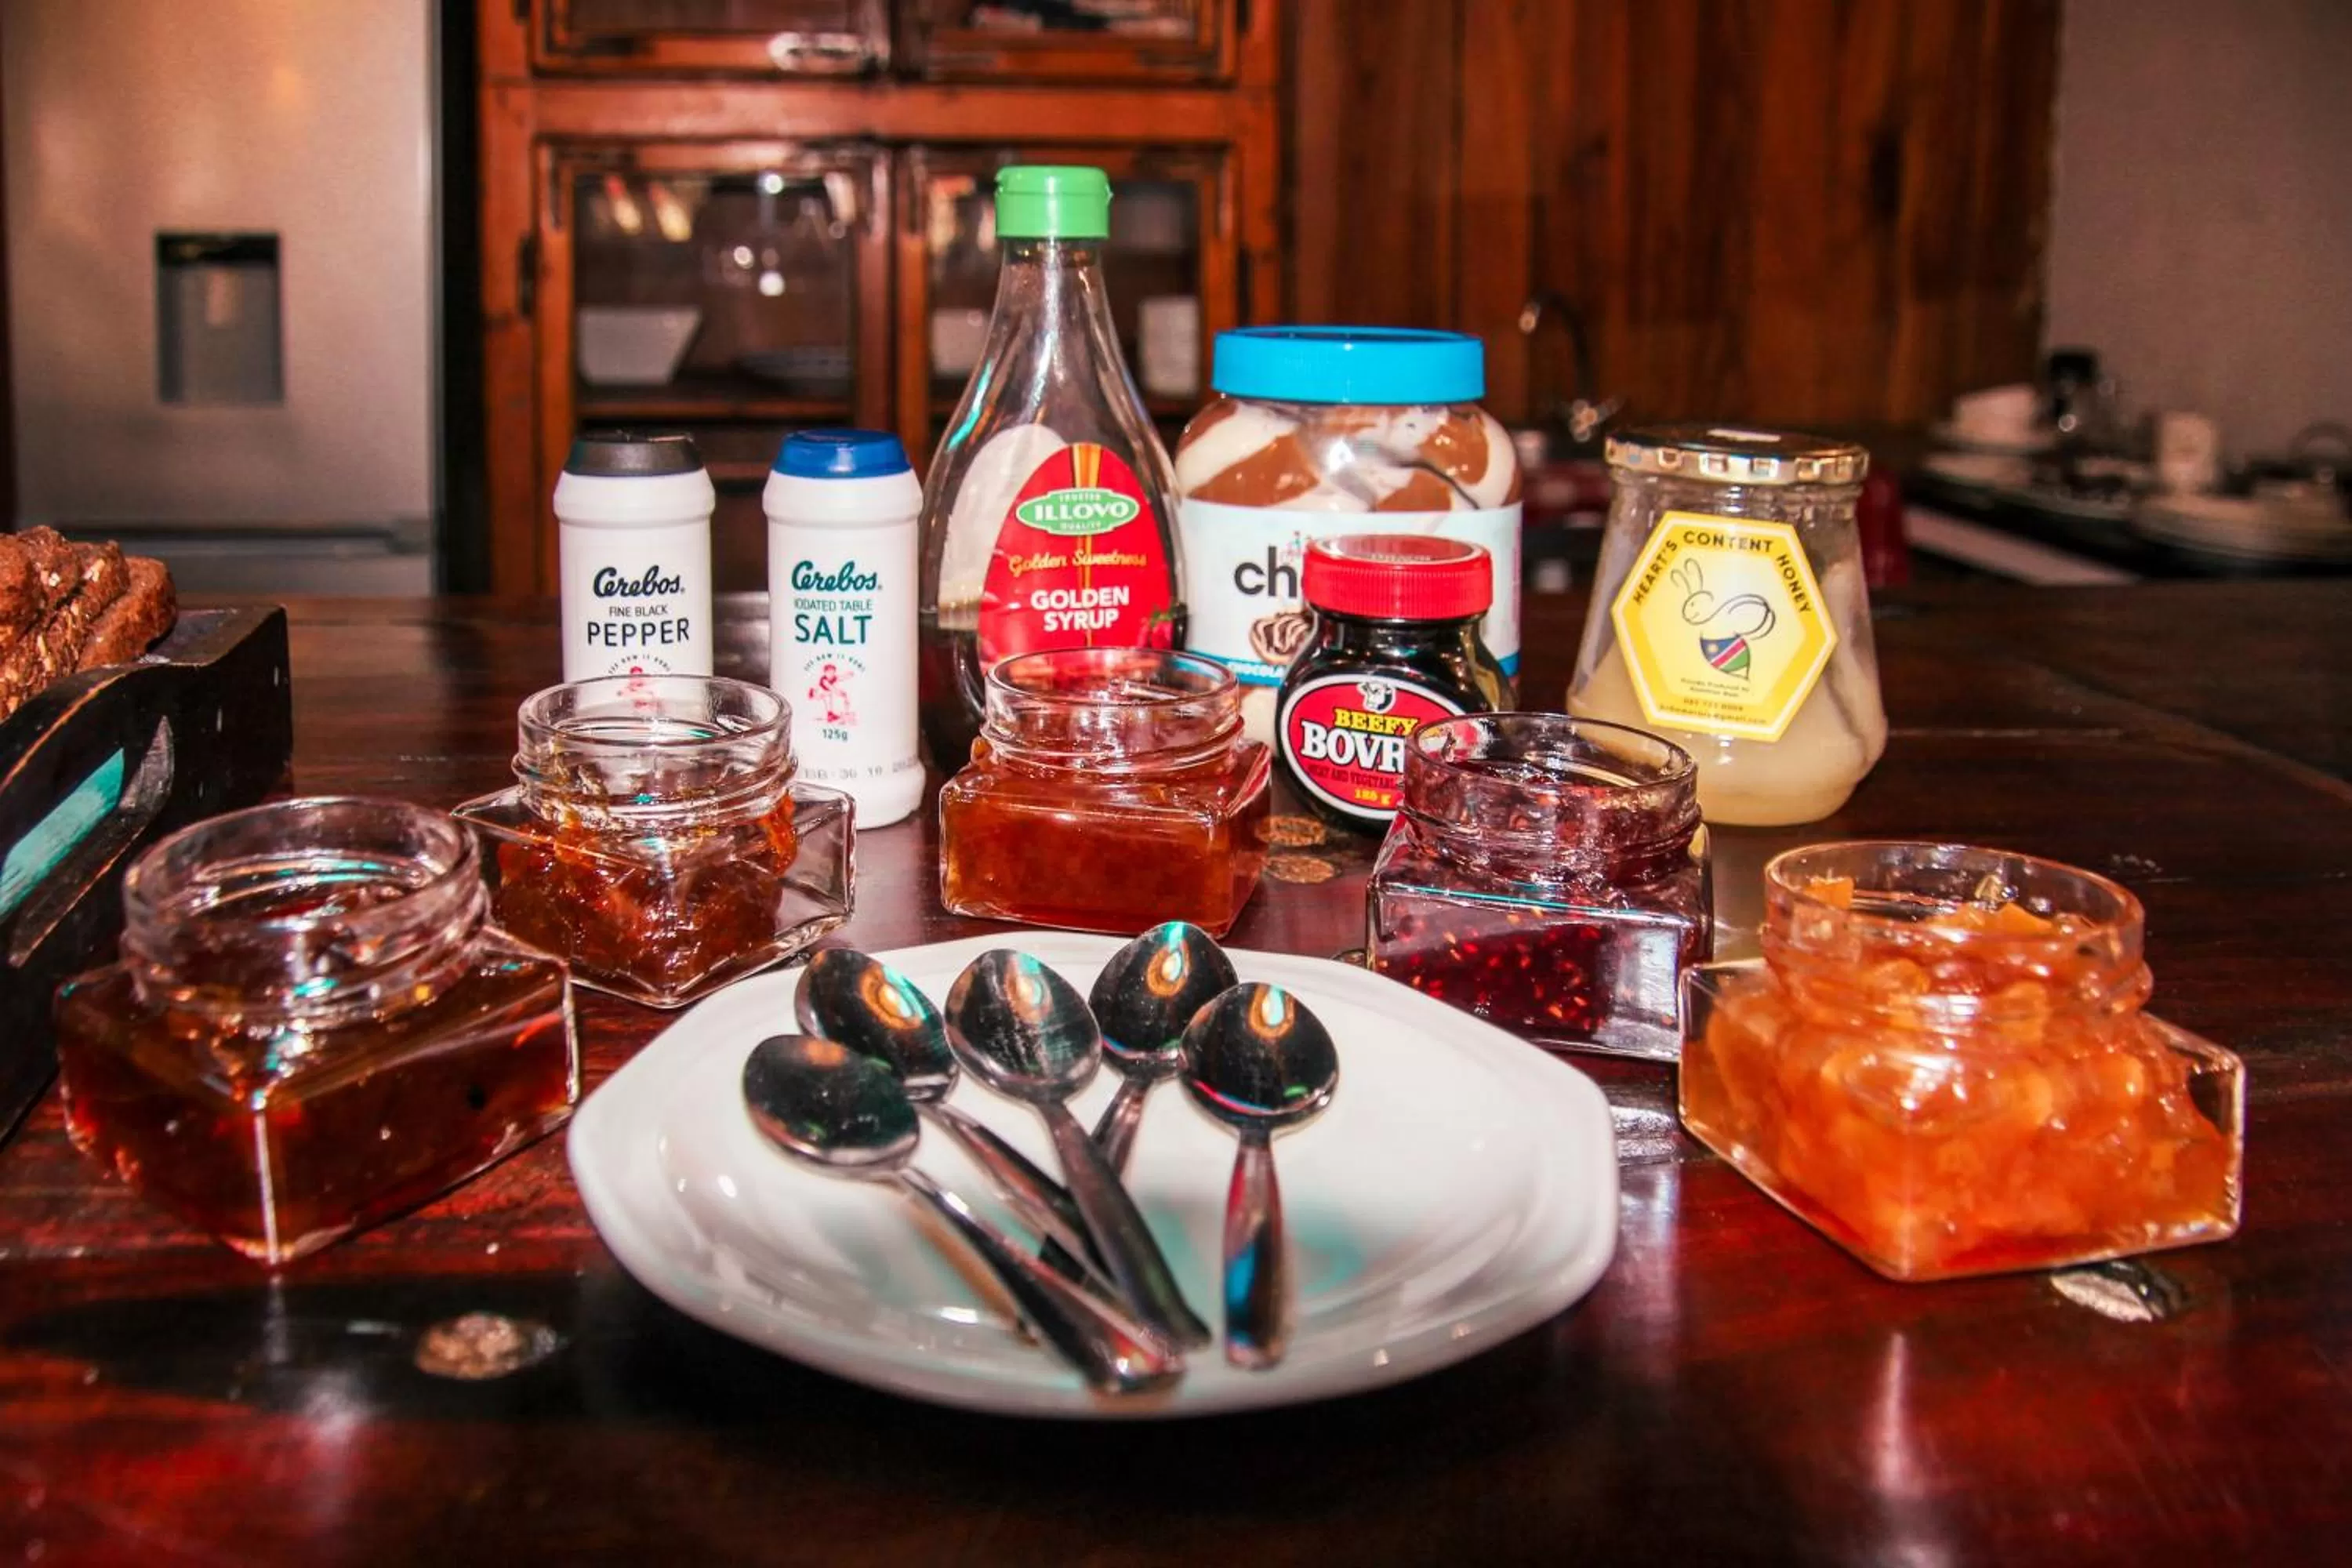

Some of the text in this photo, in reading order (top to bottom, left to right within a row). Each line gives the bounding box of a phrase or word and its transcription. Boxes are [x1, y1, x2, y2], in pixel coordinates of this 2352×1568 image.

[1034, 501, 1130, 521] ILLOVO
[791, 560, 877, 592] Cerebos
[1008, 551, 1067, 578] Golden
[1633, 530, 1812, 614] HEART'S CONTENT HONEY
[593, 564, 681, 597] Cerebos
[609, 604, 668, 617] FINE BLACK
[840, 600, 873, 611] TABLE
[1030, 586, 1131, 611] GOLDEN
[587, 617, 690, 647] PEPPER
[794, 614, 873, 644] SALT
[1044, 608, 1120, 632] SYRUP
[822, 729, 848, 742] 125g
[1334, 708, 1418, 736] BEEFY
[1301, 720, 1406, 774] BOVR
